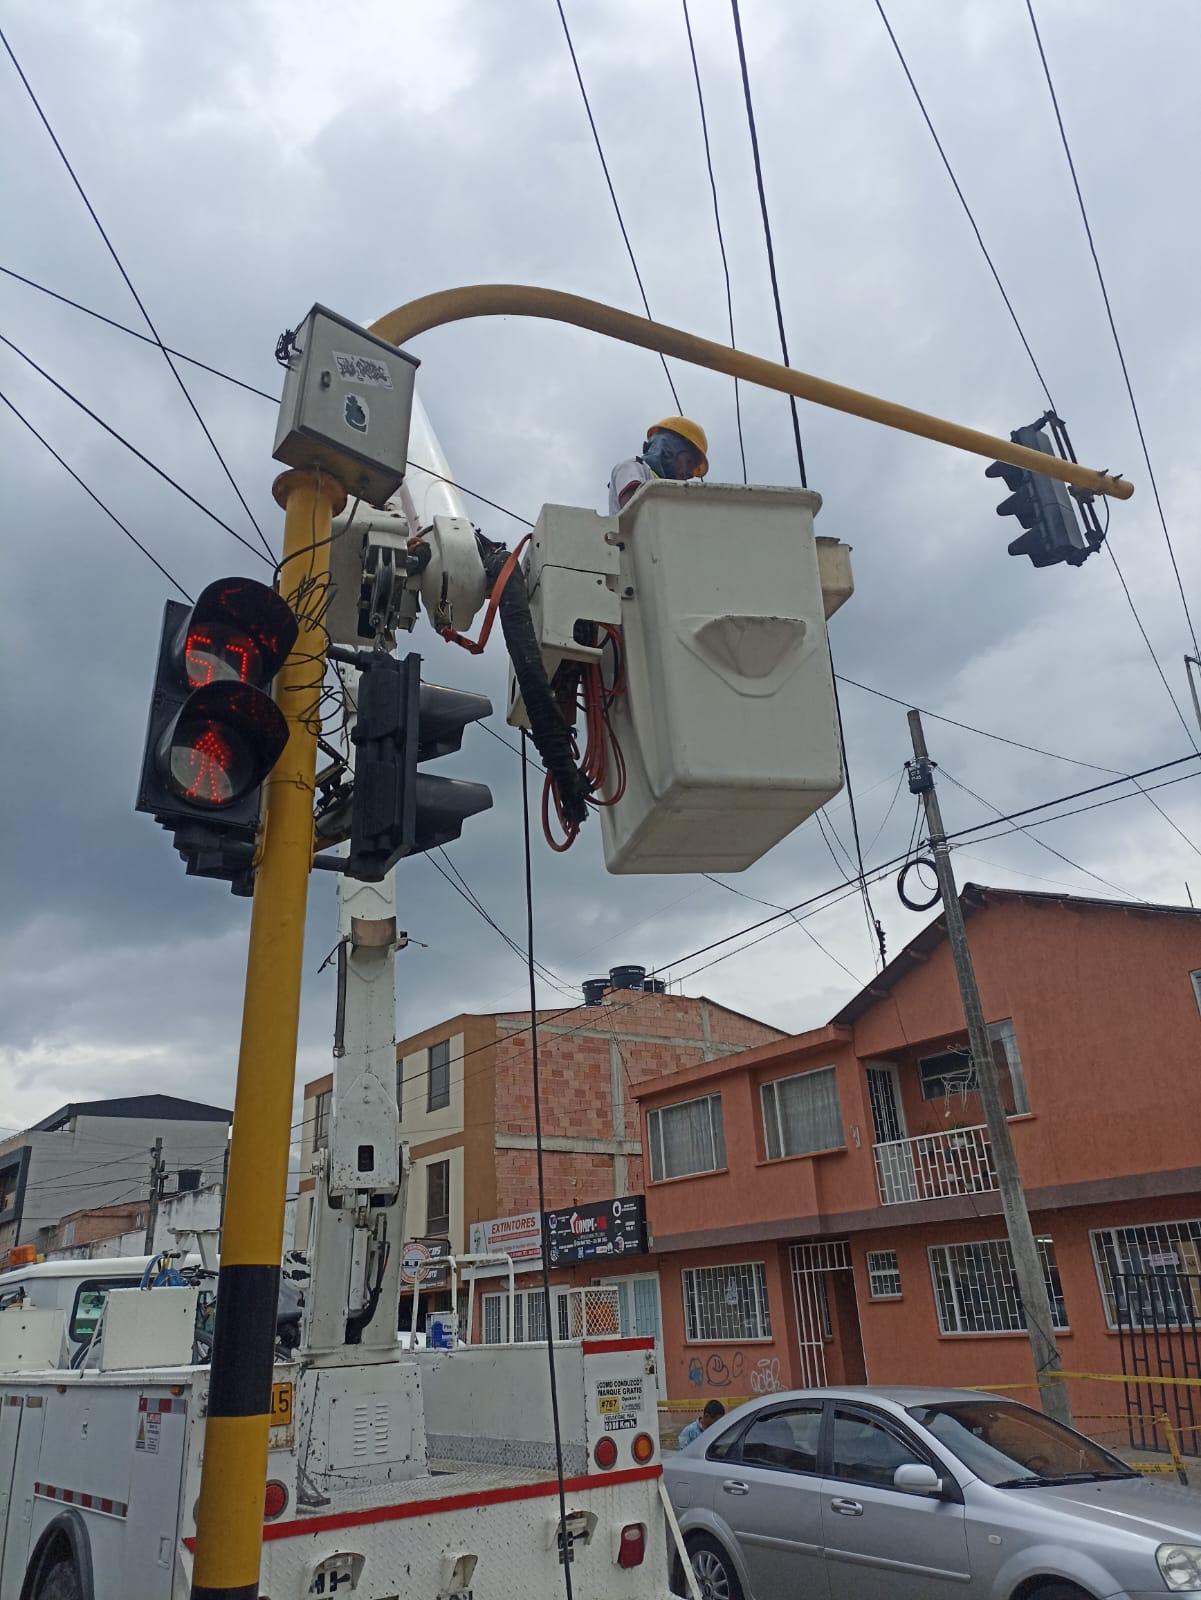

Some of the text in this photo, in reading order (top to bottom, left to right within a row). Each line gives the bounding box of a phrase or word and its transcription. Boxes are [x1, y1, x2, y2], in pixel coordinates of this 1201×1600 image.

[491, 1217, 536, 1235] EXTINTORES
[598, 1387, 642, 1396] MARQUE GRATIS
[601, 1399, 618, 1408] #767
